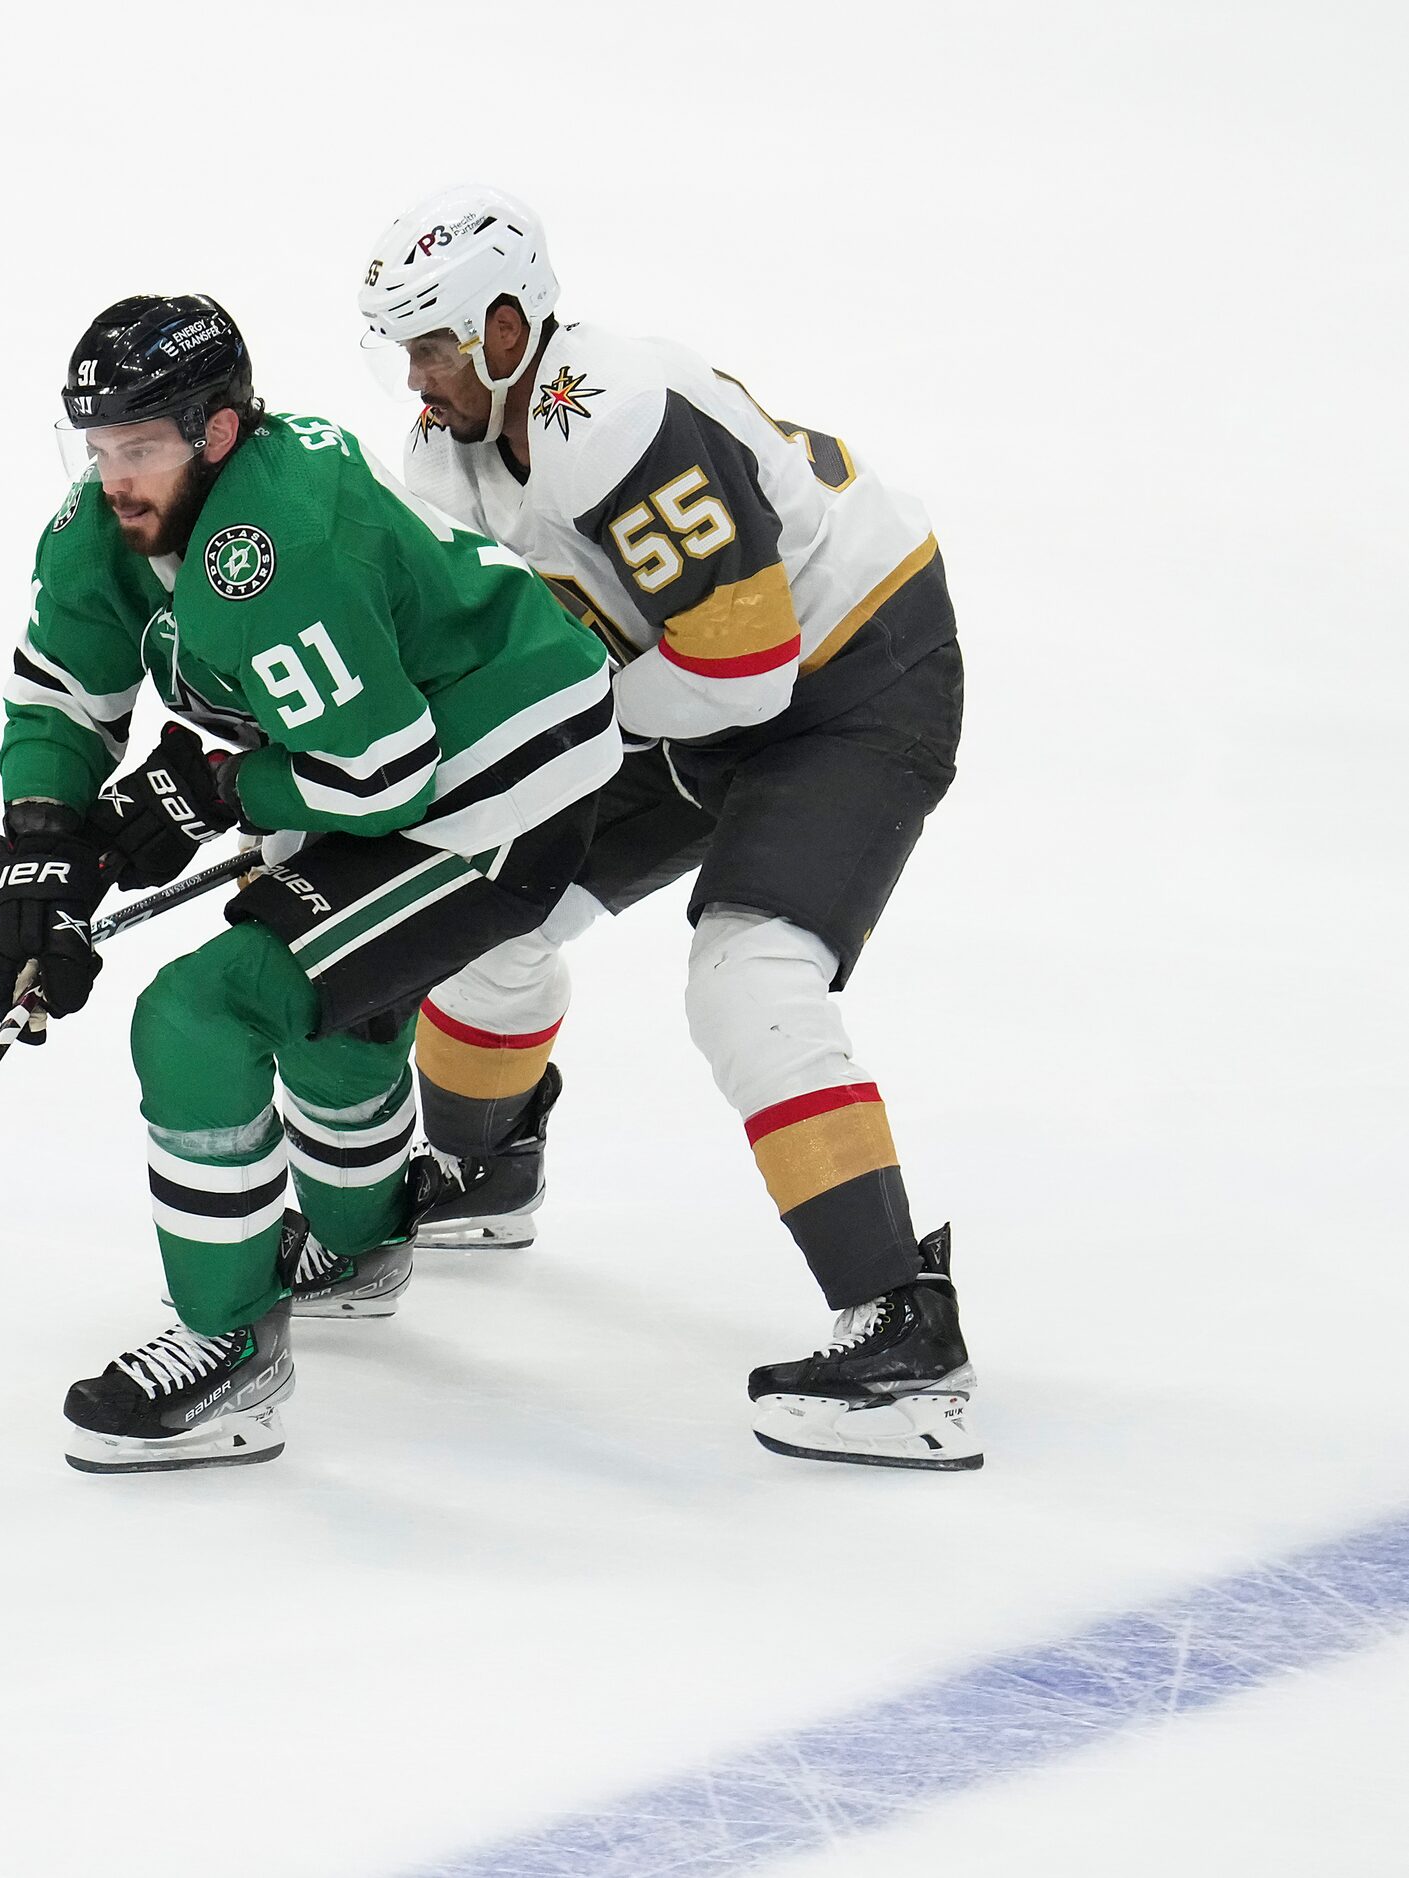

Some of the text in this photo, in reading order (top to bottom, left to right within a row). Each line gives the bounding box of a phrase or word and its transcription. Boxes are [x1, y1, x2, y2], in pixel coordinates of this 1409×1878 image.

[417, 225, 453, 257] P3
[172, 319, 207, 343] ENERGY
[178, 325, 221, 352] TRANSFER
[77, 359, 99, 387] 91
[607, 463, 737, 595] 55
[208, 529, 260, 576] DALLAS
[225, 553, 271, 595] STARS
[251, 620, 364, 730] 91
